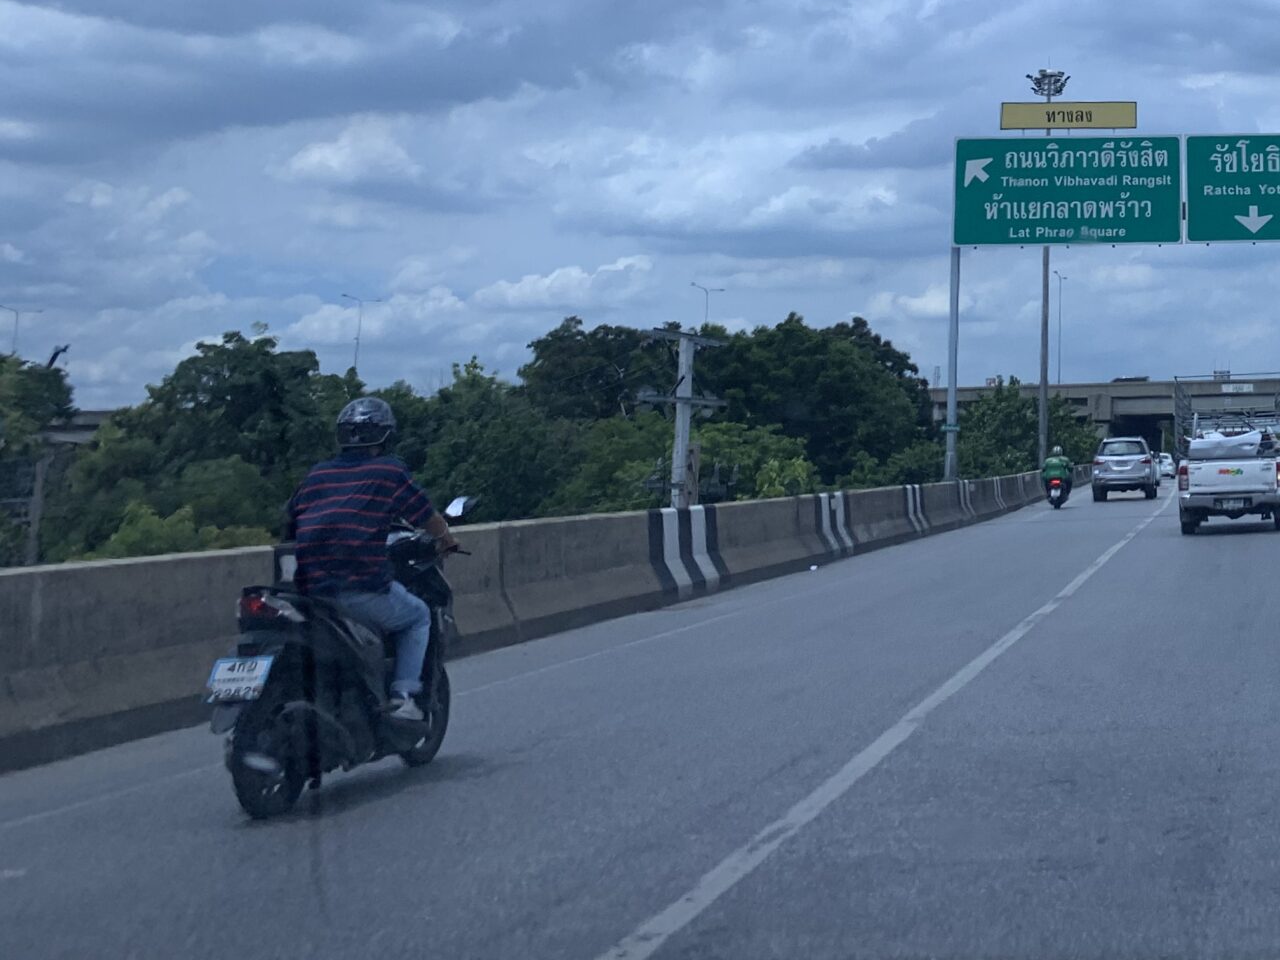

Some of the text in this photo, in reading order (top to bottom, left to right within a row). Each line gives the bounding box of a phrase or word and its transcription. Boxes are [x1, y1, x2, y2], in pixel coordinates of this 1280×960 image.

[1046, 109, 1093, 123] ทางลง
[1005, 141, 1169, 169] ถนนวิภาวดีรังสิต
[1001, 174, 1172, 188] Thanon Vibhavadi Rangsit
[1204, 185, 1251, 196] Ratcha
[984, 192, 1152, 220] ห้าแยกลาดพร้าว
[1009, 227, 1030, 238] Lat
[1035, 227, 1074, 238] Phrao
